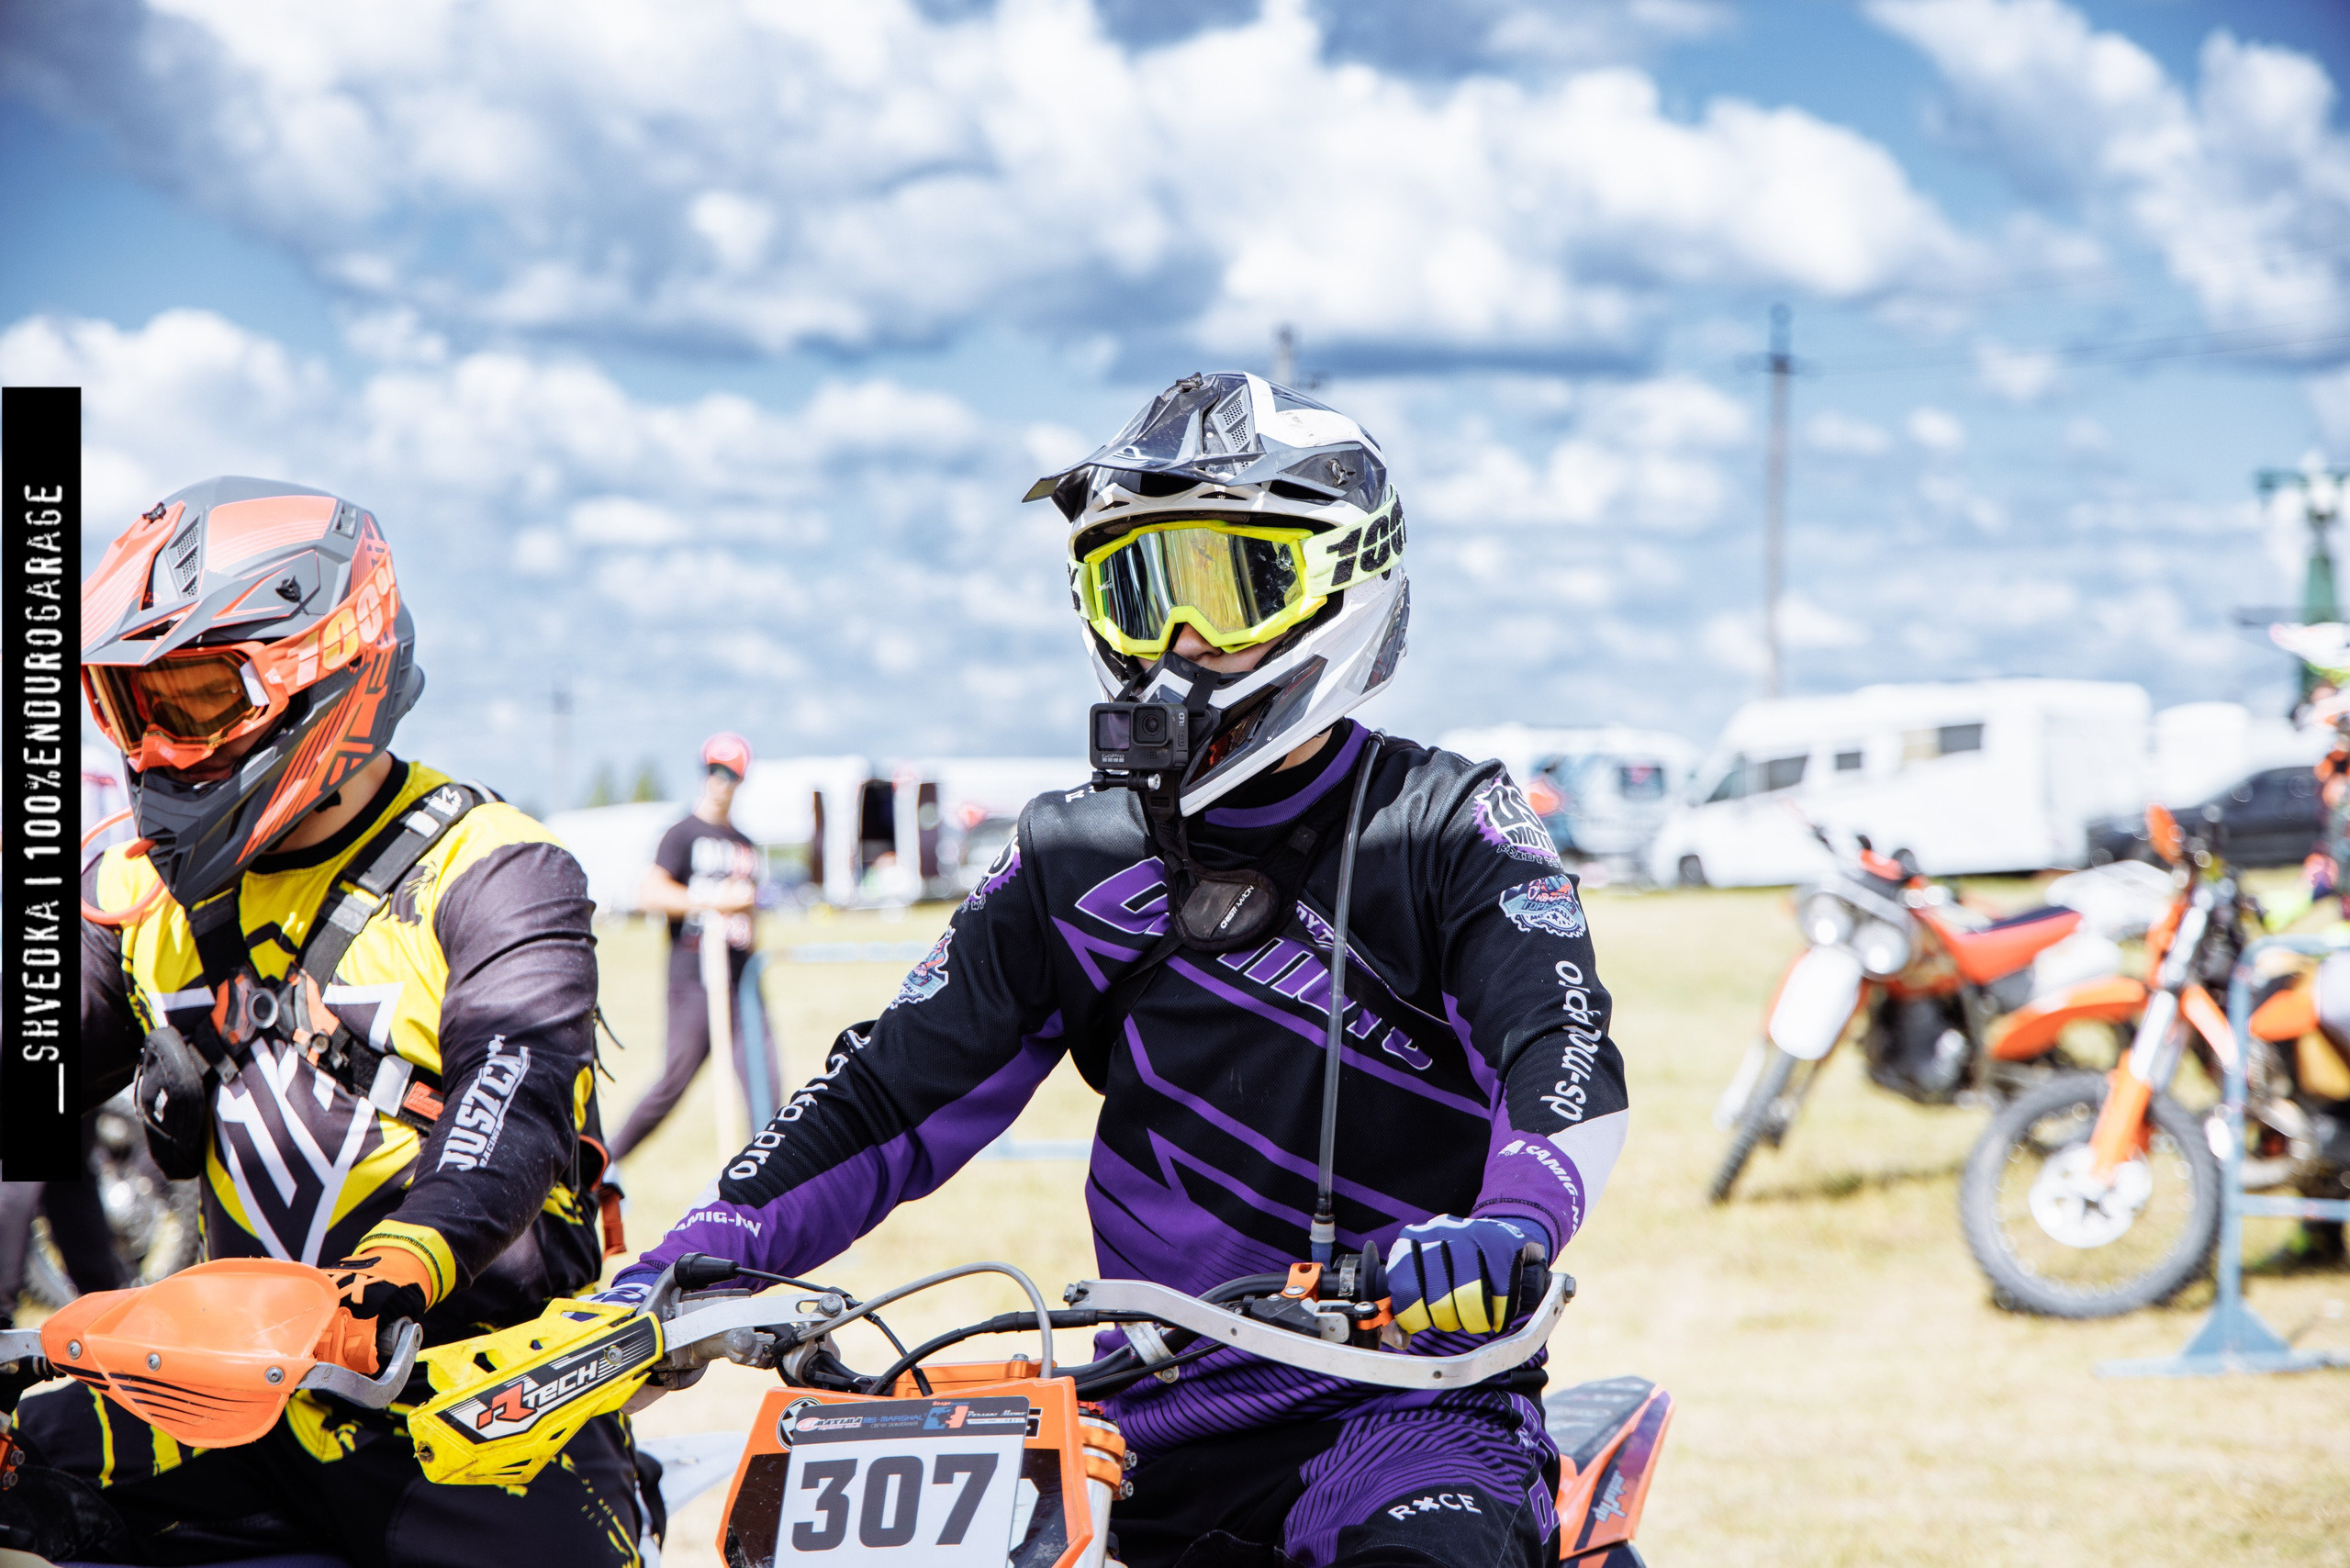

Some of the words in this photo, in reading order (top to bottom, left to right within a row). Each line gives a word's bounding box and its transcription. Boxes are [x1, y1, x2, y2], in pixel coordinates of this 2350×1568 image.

[1496, 843, 1543, 865] READY
[478, 1128, 501, 1169] RACING
[791, 1452, 1000, 1552] 307
